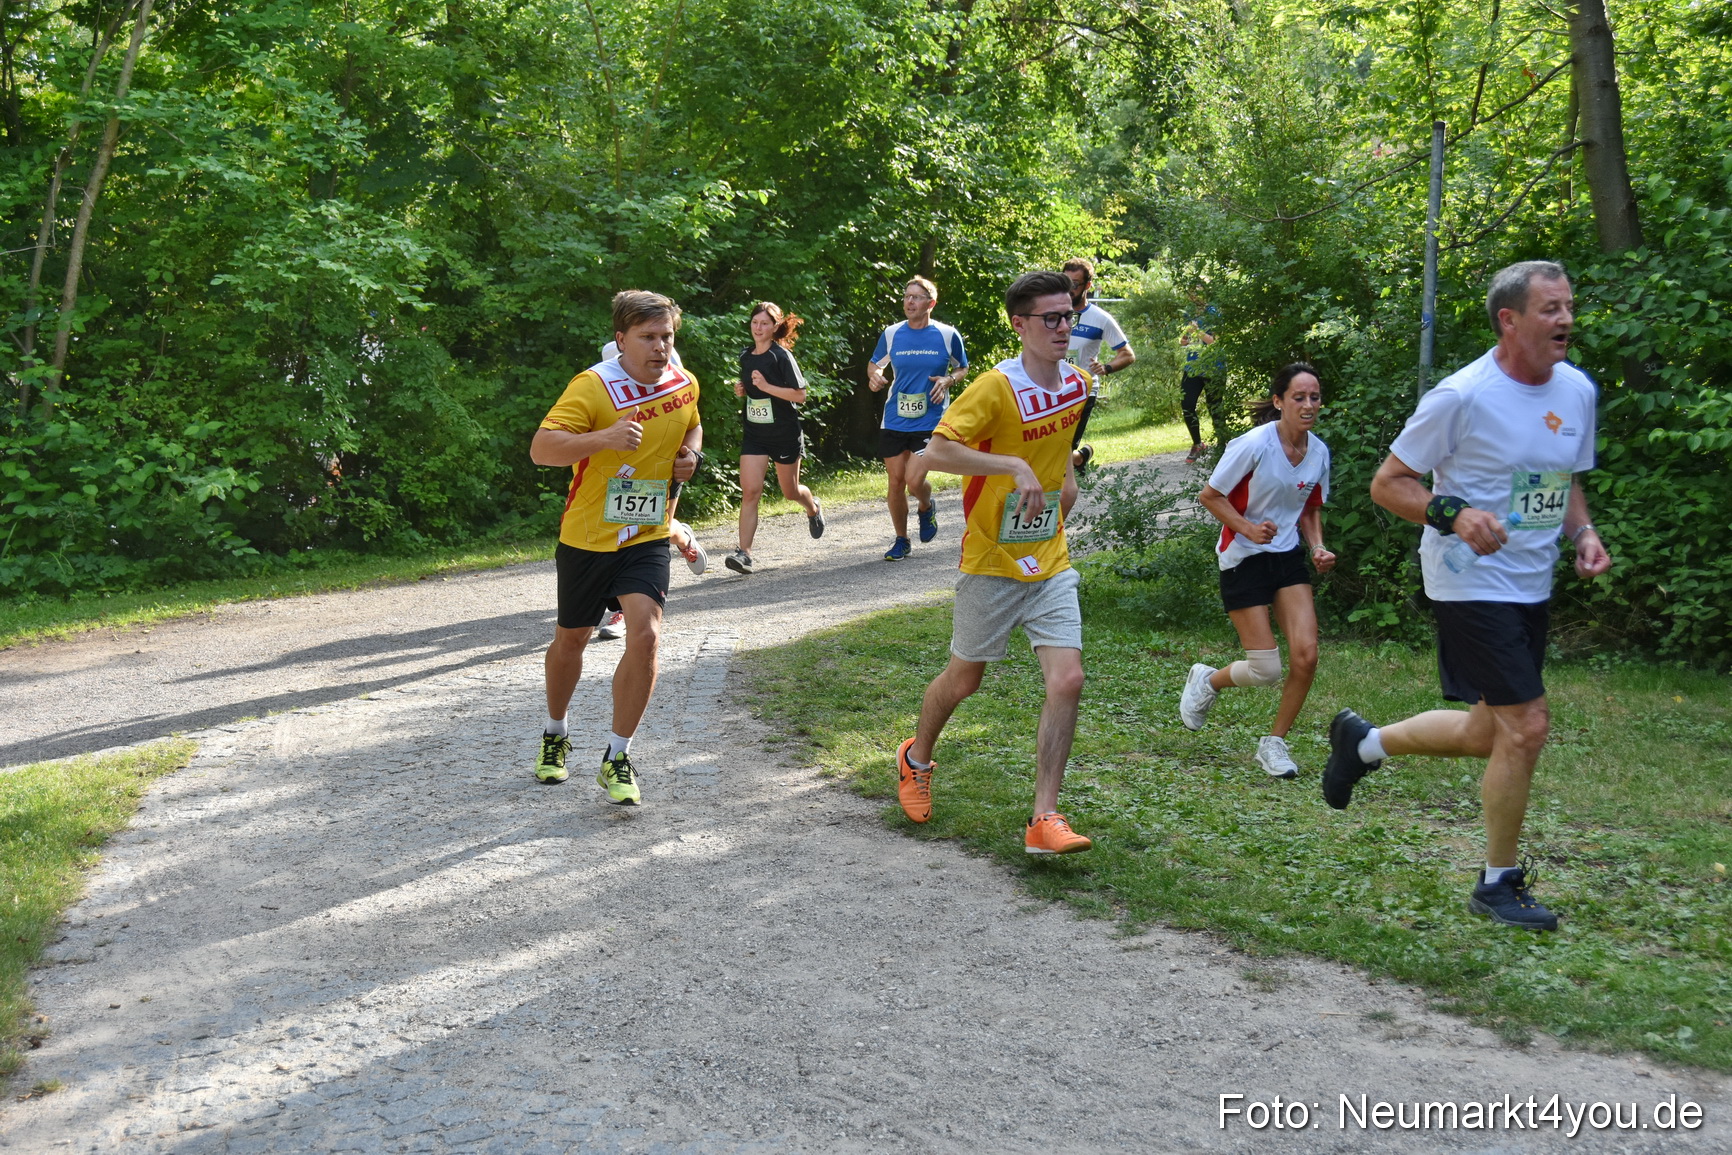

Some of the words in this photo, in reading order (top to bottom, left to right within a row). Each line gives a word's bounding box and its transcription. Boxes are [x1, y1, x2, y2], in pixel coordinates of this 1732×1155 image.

[622, 406, 659, 423] AX
[661, 391, 695, 414] BÖGL
[748, 406, 768, 417] 1983
[900, 401, 924, 412] 2156
[1022, 421, 1058, 442] MAX
[614, 494, 657, 513] 1571
[1520, 490, 1565, 514] 1344
